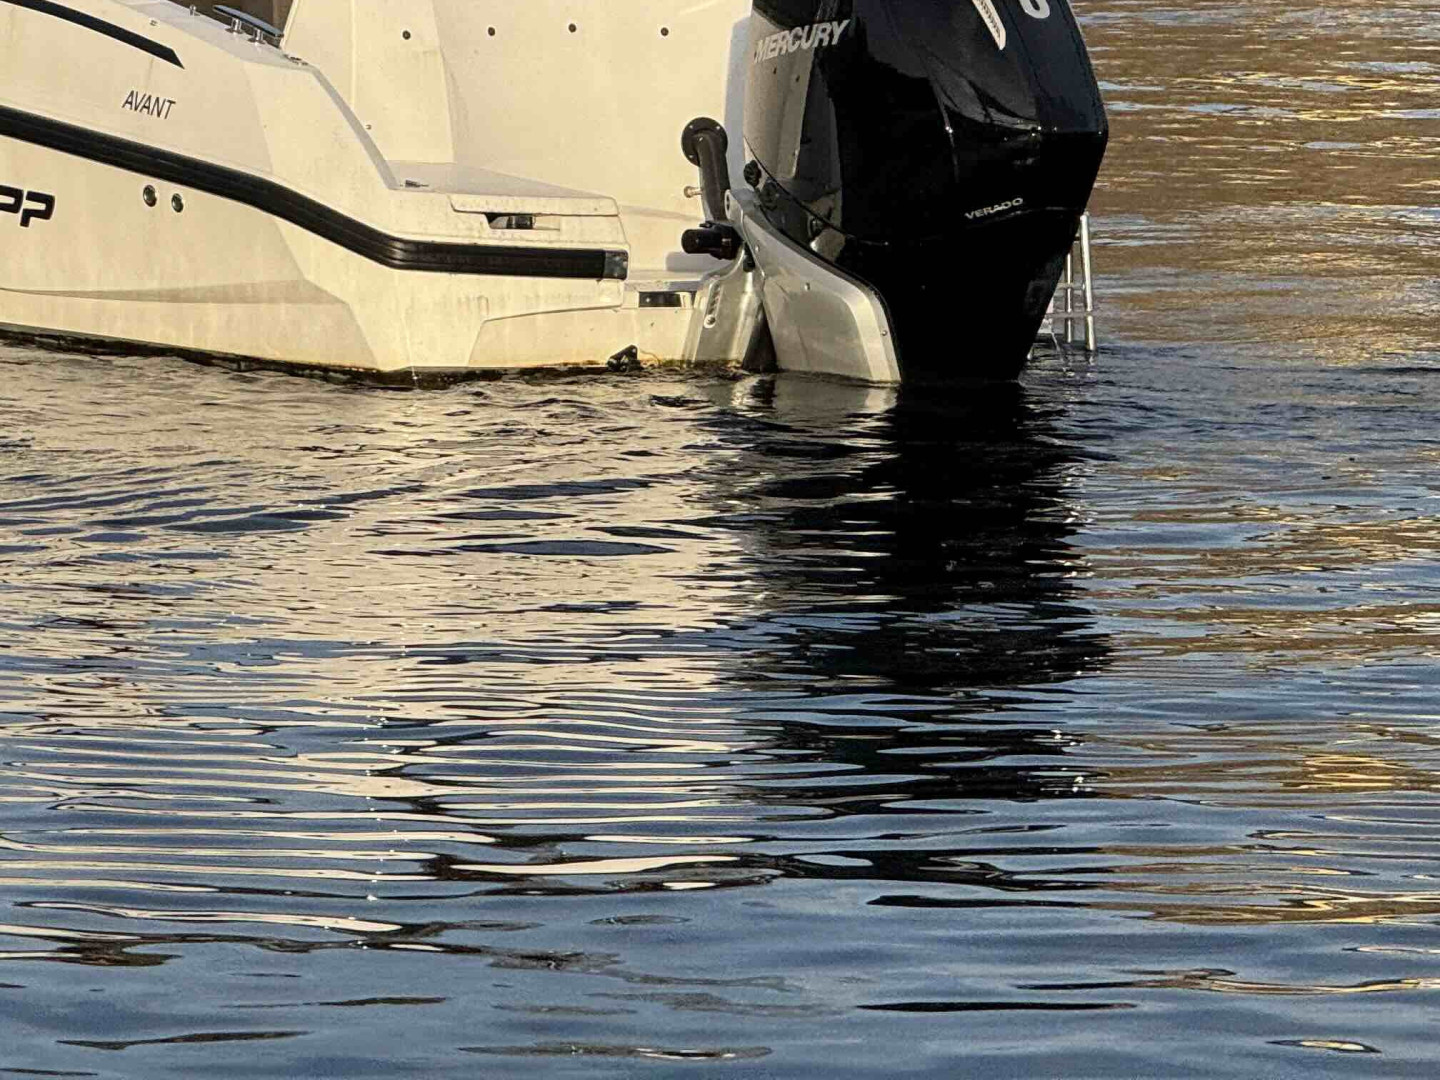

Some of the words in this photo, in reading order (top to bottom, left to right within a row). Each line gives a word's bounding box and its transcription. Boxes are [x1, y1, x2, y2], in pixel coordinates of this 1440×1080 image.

[753, 19, 851, 62] MERCURY
[121, 89, 177, 120] AVANT
[964, 197, 1024, 220] VERADO
